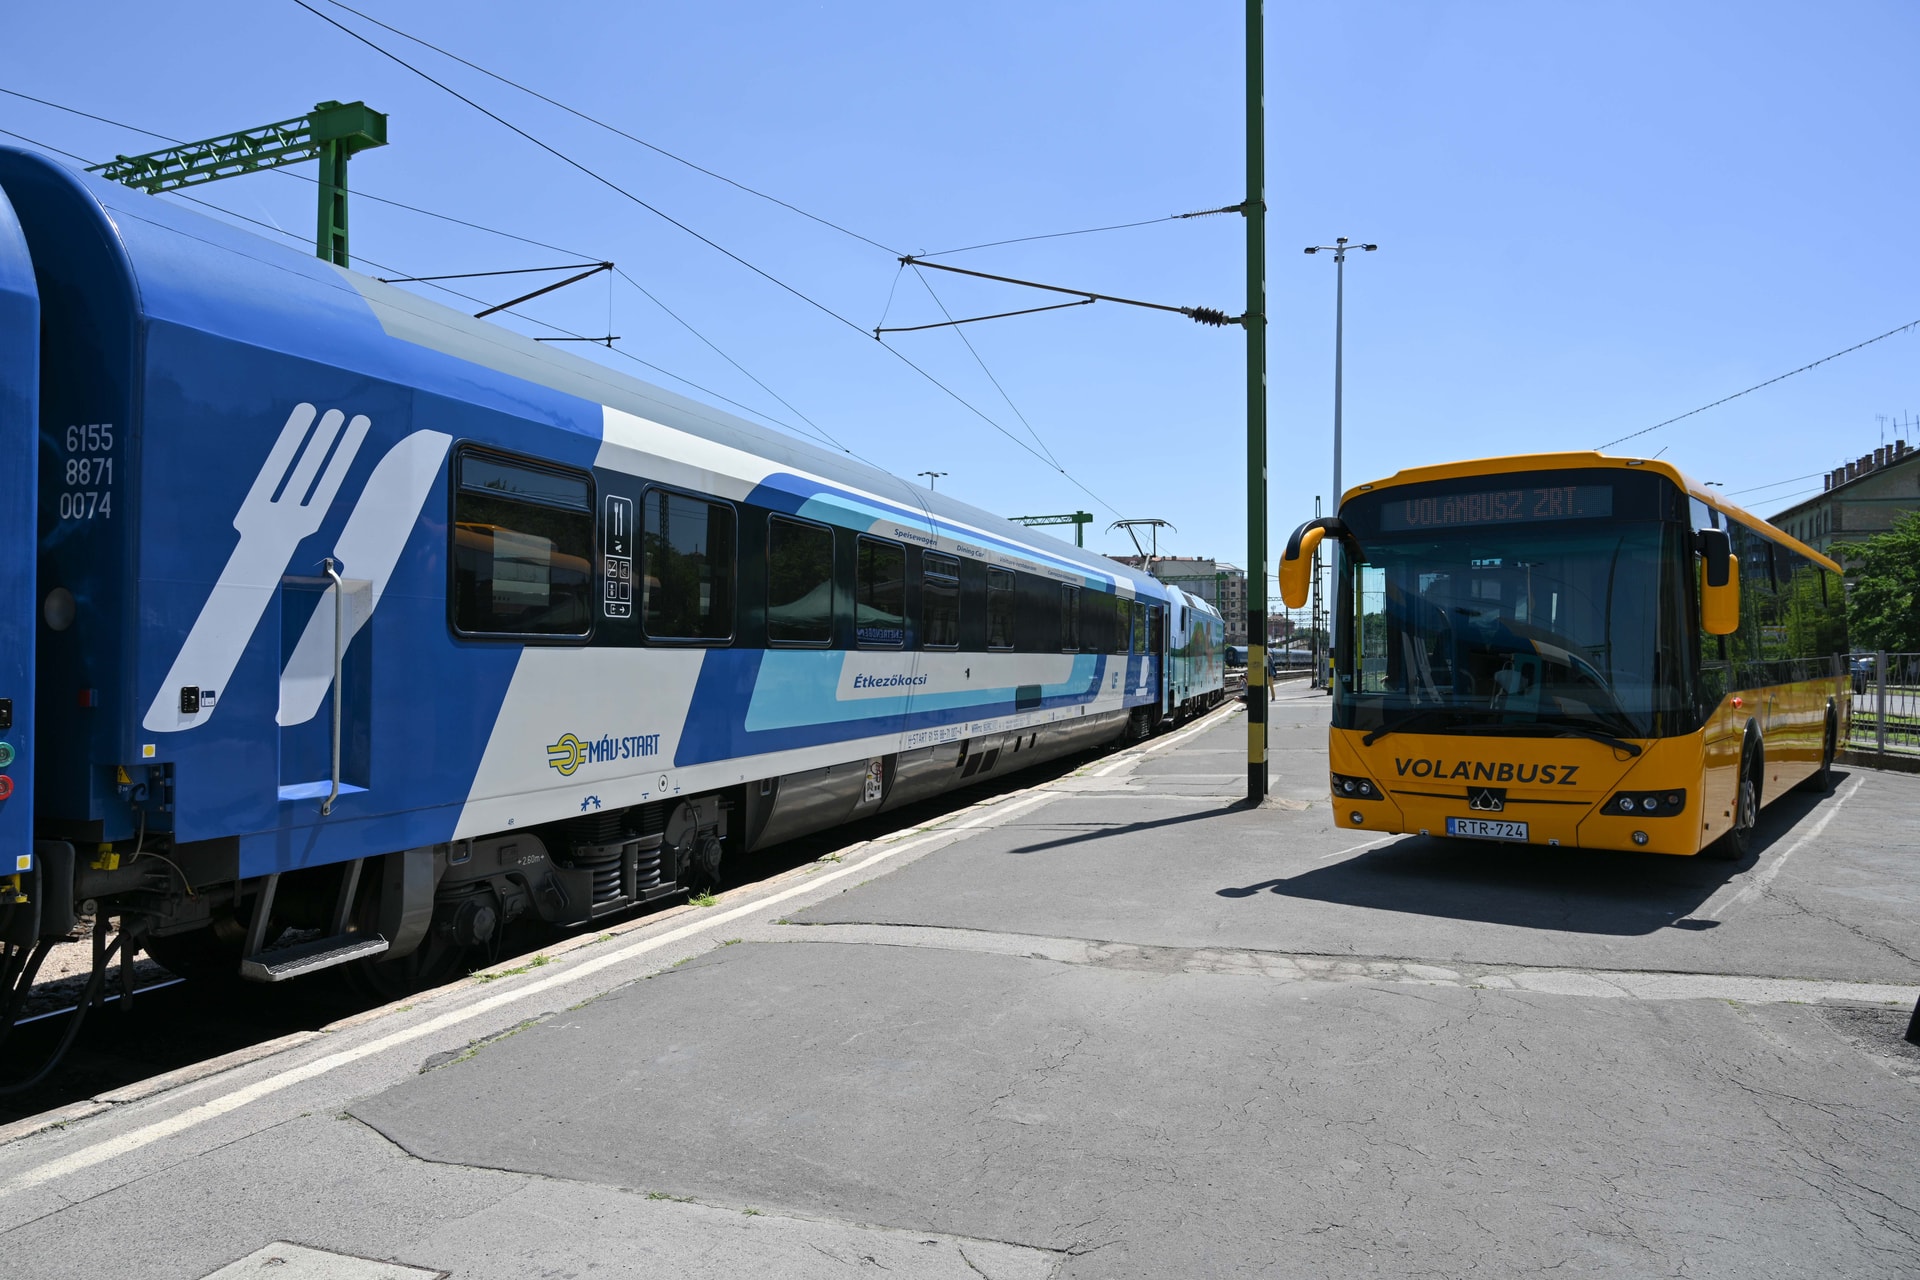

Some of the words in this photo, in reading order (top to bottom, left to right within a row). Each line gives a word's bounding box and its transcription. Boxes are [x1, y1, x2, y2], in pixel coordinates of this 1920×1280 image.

[66, 424, 113, 452] 6155
[66, 458, 113, 486] 8871
[60, 491, 112, 519] 0074
[1406, 490, 1523, 526] VOLÁNBUSZ
[1533, 486, 1583, 517] ZRT.
[894, 528, 938, 546] Speisewagen
[957, 545, 975, 557] Dining
[853, 673, 928, 689] Étkezőkocsi
[588, 734, 660, 763] MÁV-START
[1395, 757, 1580, 785] VOLÁNBUSZ
[1458, 820, 1523, 838] RTR-724
